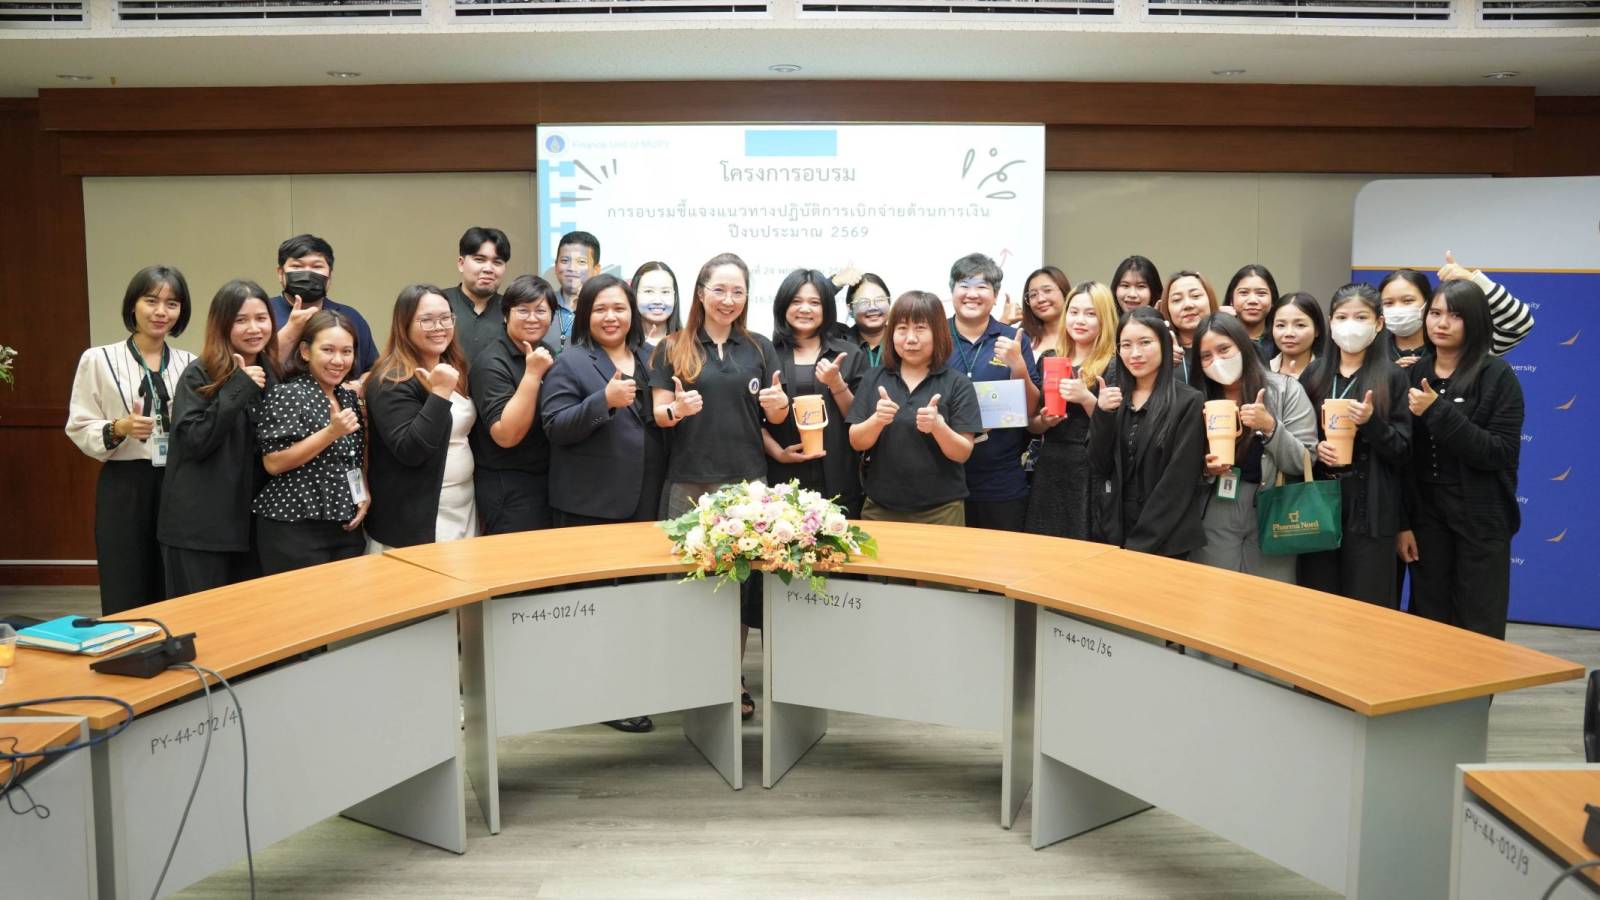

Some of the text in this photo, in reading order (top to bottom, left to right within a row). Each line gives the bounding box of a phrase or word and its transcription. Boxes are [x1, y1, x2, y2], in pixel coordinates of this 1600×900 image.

[719, 160, 855, 182] โครงการอบรม
[728, 223, 870, 238] ปีงบประมาณ 2569
[1511, 364, 1537, 373] versity
[511, 600, 596, 624] PY-44-012/44
[150, 706, 242, 755] PY-44-012/4
